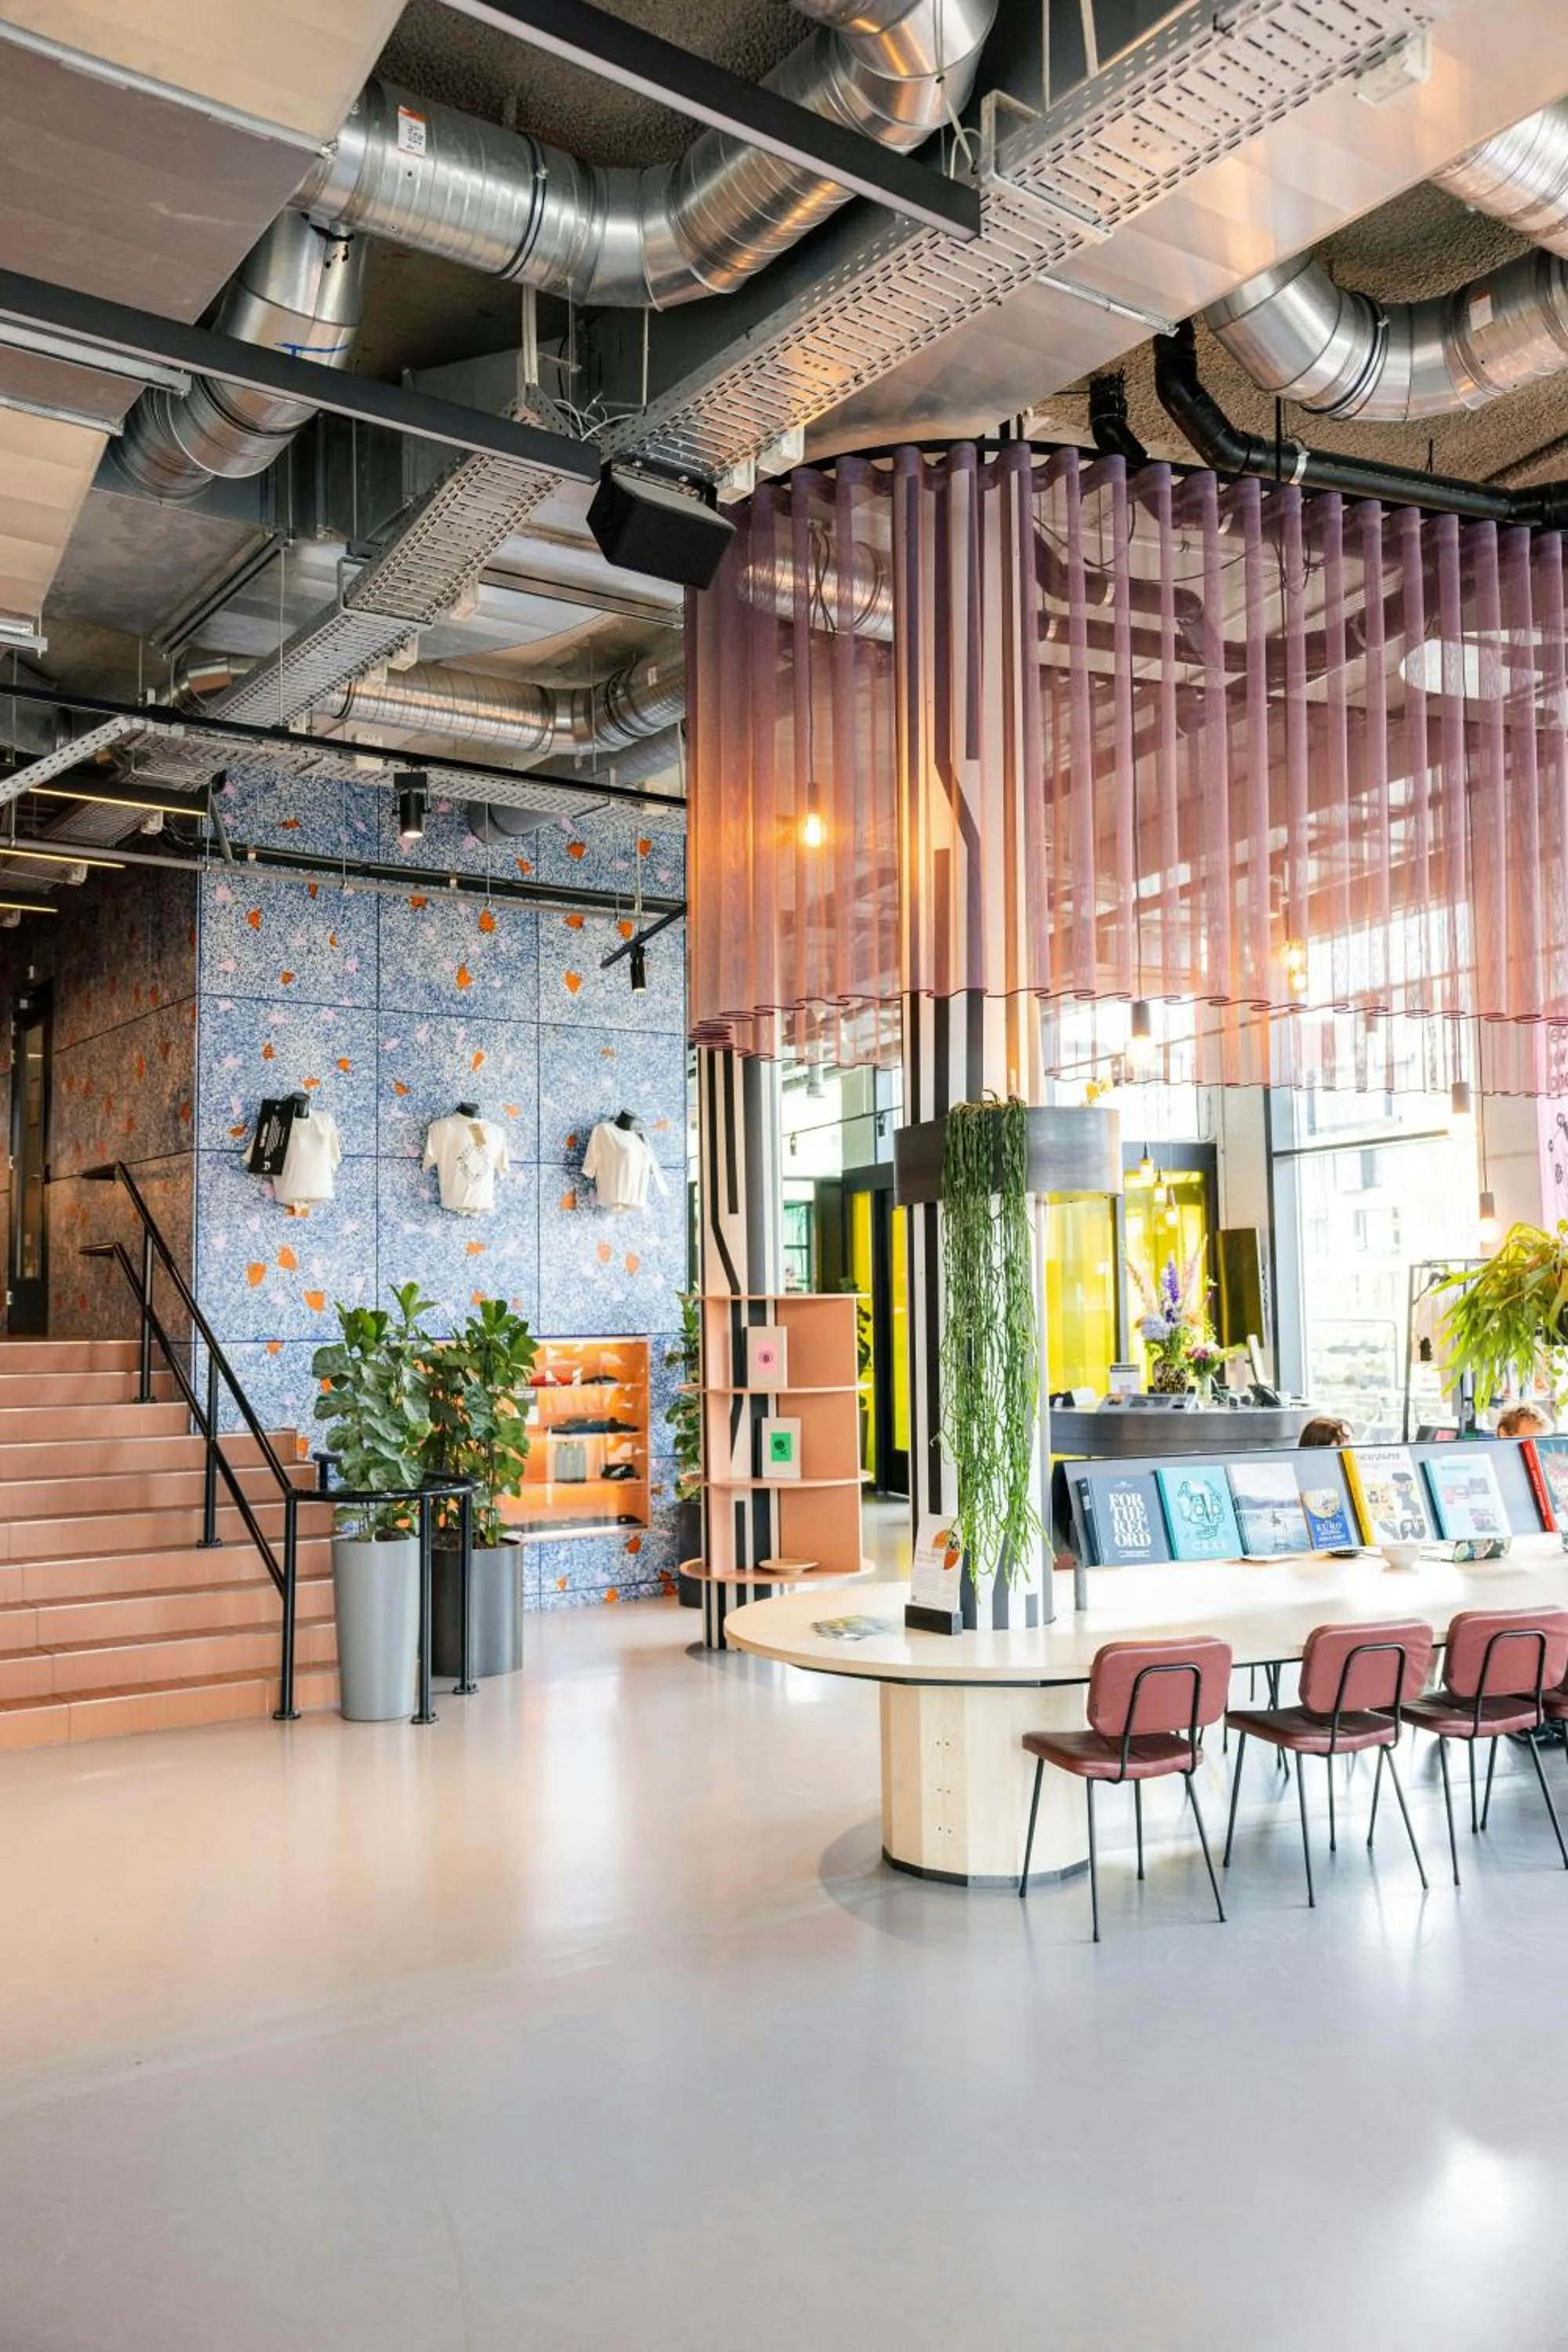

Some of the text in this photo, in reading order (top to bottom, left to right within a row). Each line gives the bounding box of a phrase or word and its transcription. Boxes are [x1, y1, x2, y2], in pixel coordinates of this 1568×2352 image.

[1109, 1493, 1145, 1512] FOR
[1112, 1505, 1149, 1524] THE
[1114, 1533, 1152, 1547] ORD
